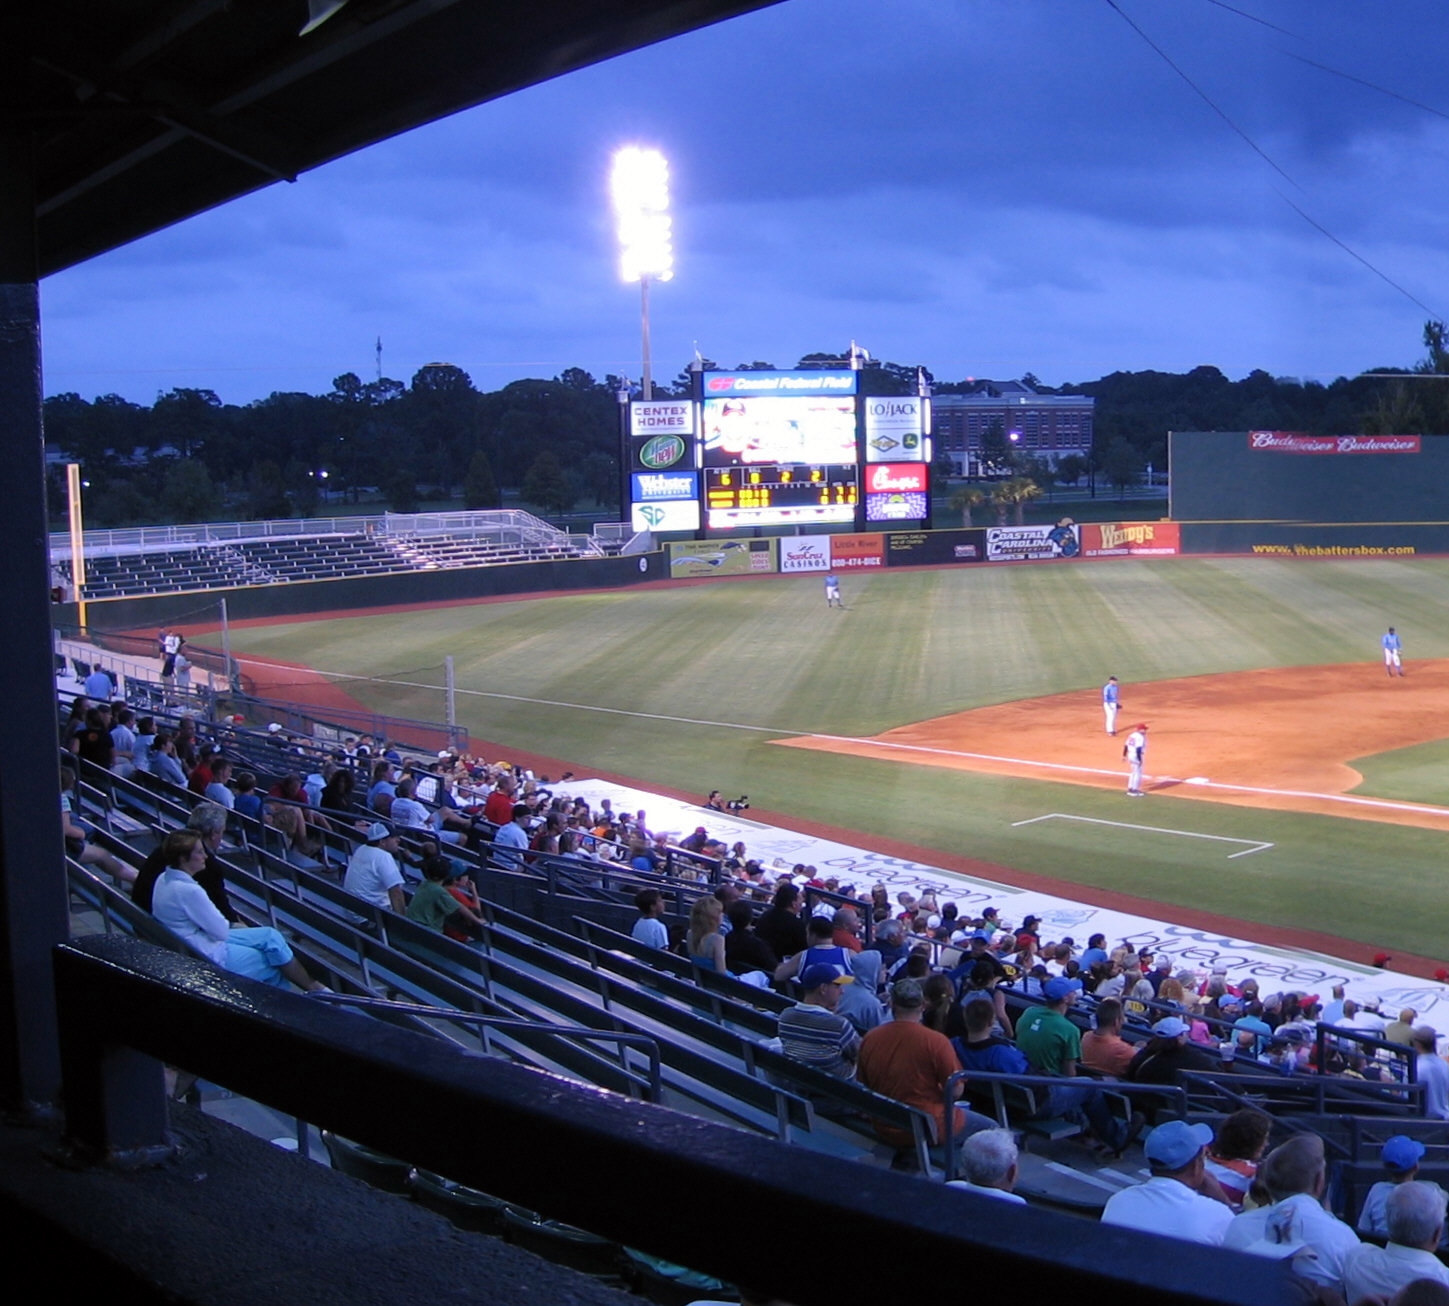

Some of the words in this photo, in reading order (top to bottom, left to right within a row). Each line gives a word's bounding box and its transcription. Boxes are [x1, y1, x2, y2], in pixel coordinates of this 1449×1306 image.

[634, 406, 687, 416] CENTEX
[638, 417, 684, 426] HOMES
[1252, 433, 1334, 451] Budweiser
[1337, 437, 1416, 452] Budweiser
[834, 541, 855, 549] Little
[784, 560, 827, 568] CASINOS
[1113, 931, 1351, 989] bluegreen
